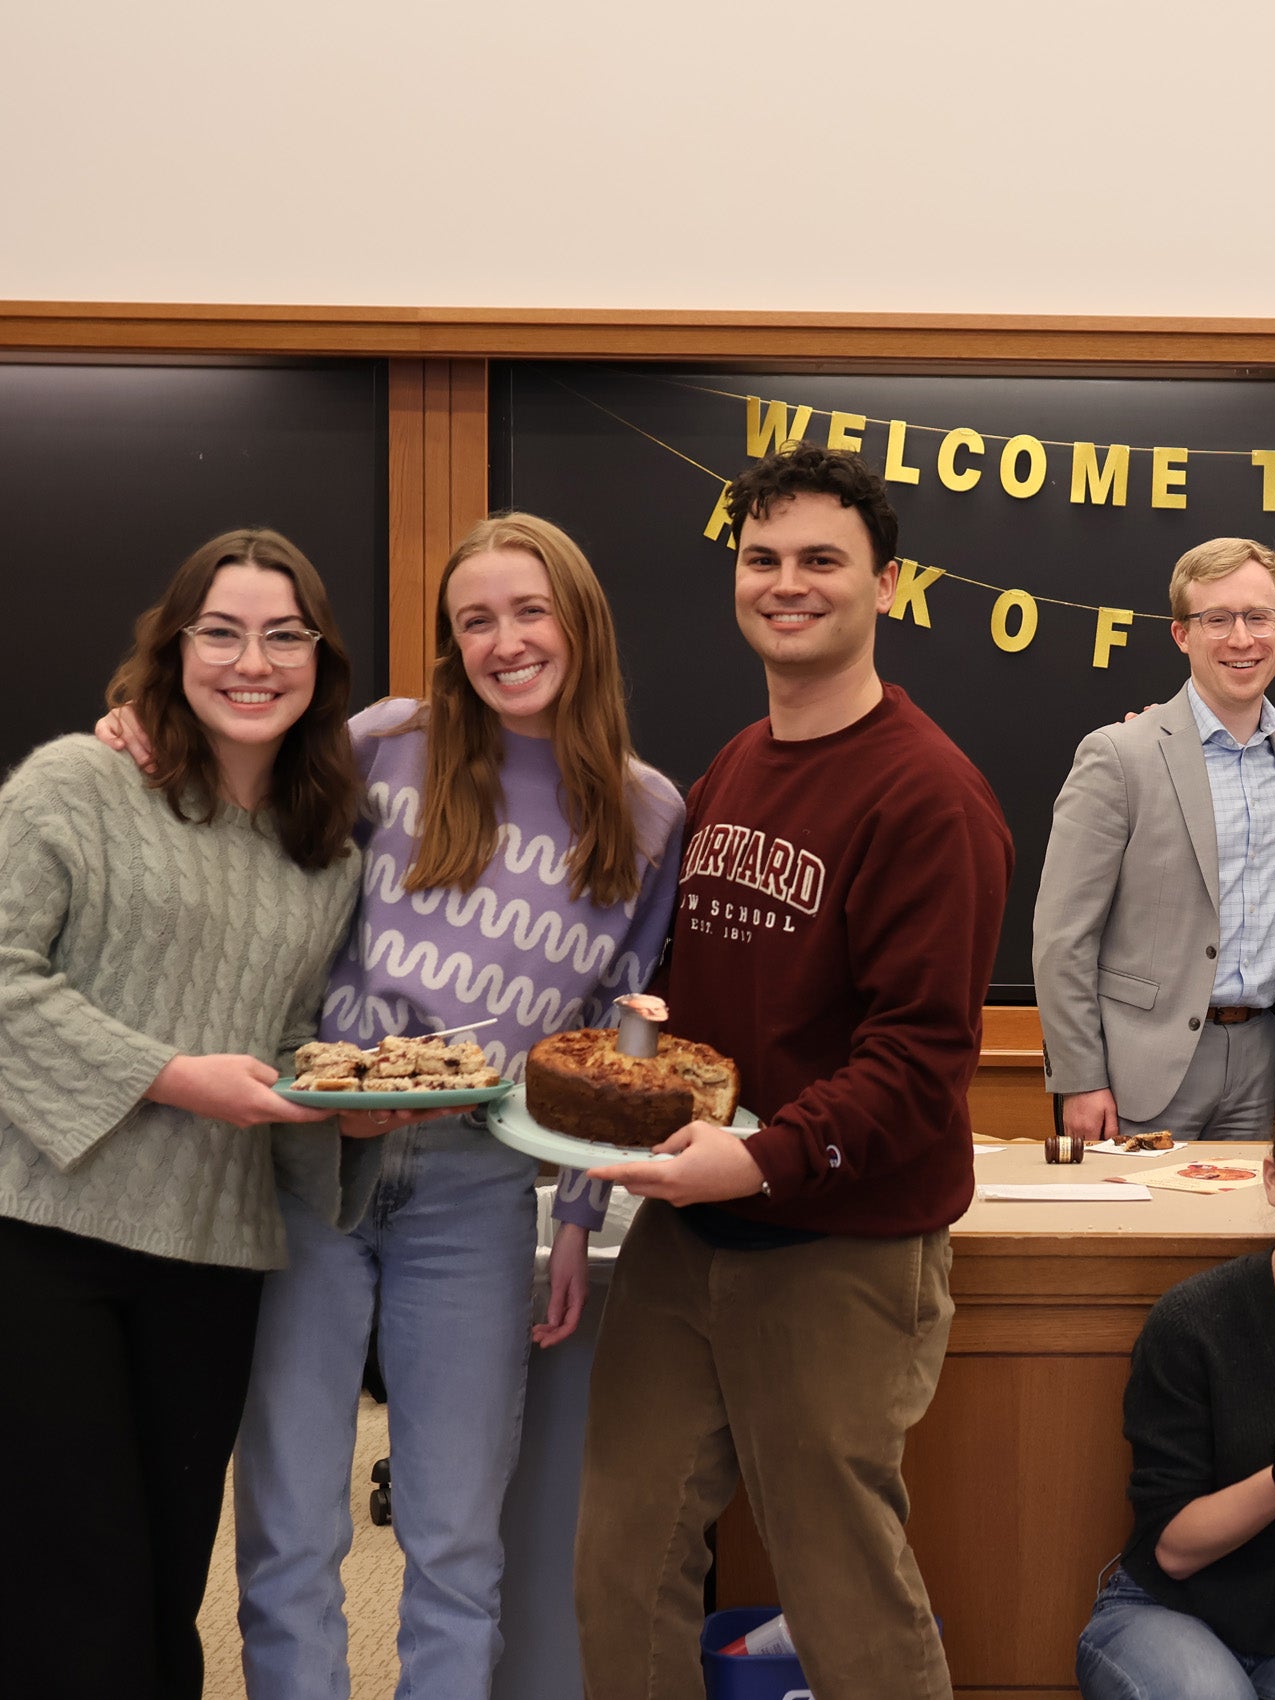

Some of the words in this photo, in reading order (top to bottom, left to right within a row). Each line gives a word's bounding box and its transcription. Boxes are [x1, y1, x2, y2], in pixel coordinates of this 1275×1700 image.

[746, 395, 1189, 511] WELCOME
[711, 899, 796, 933] SCHOOL
[723, 926, 753, 944] 1817
